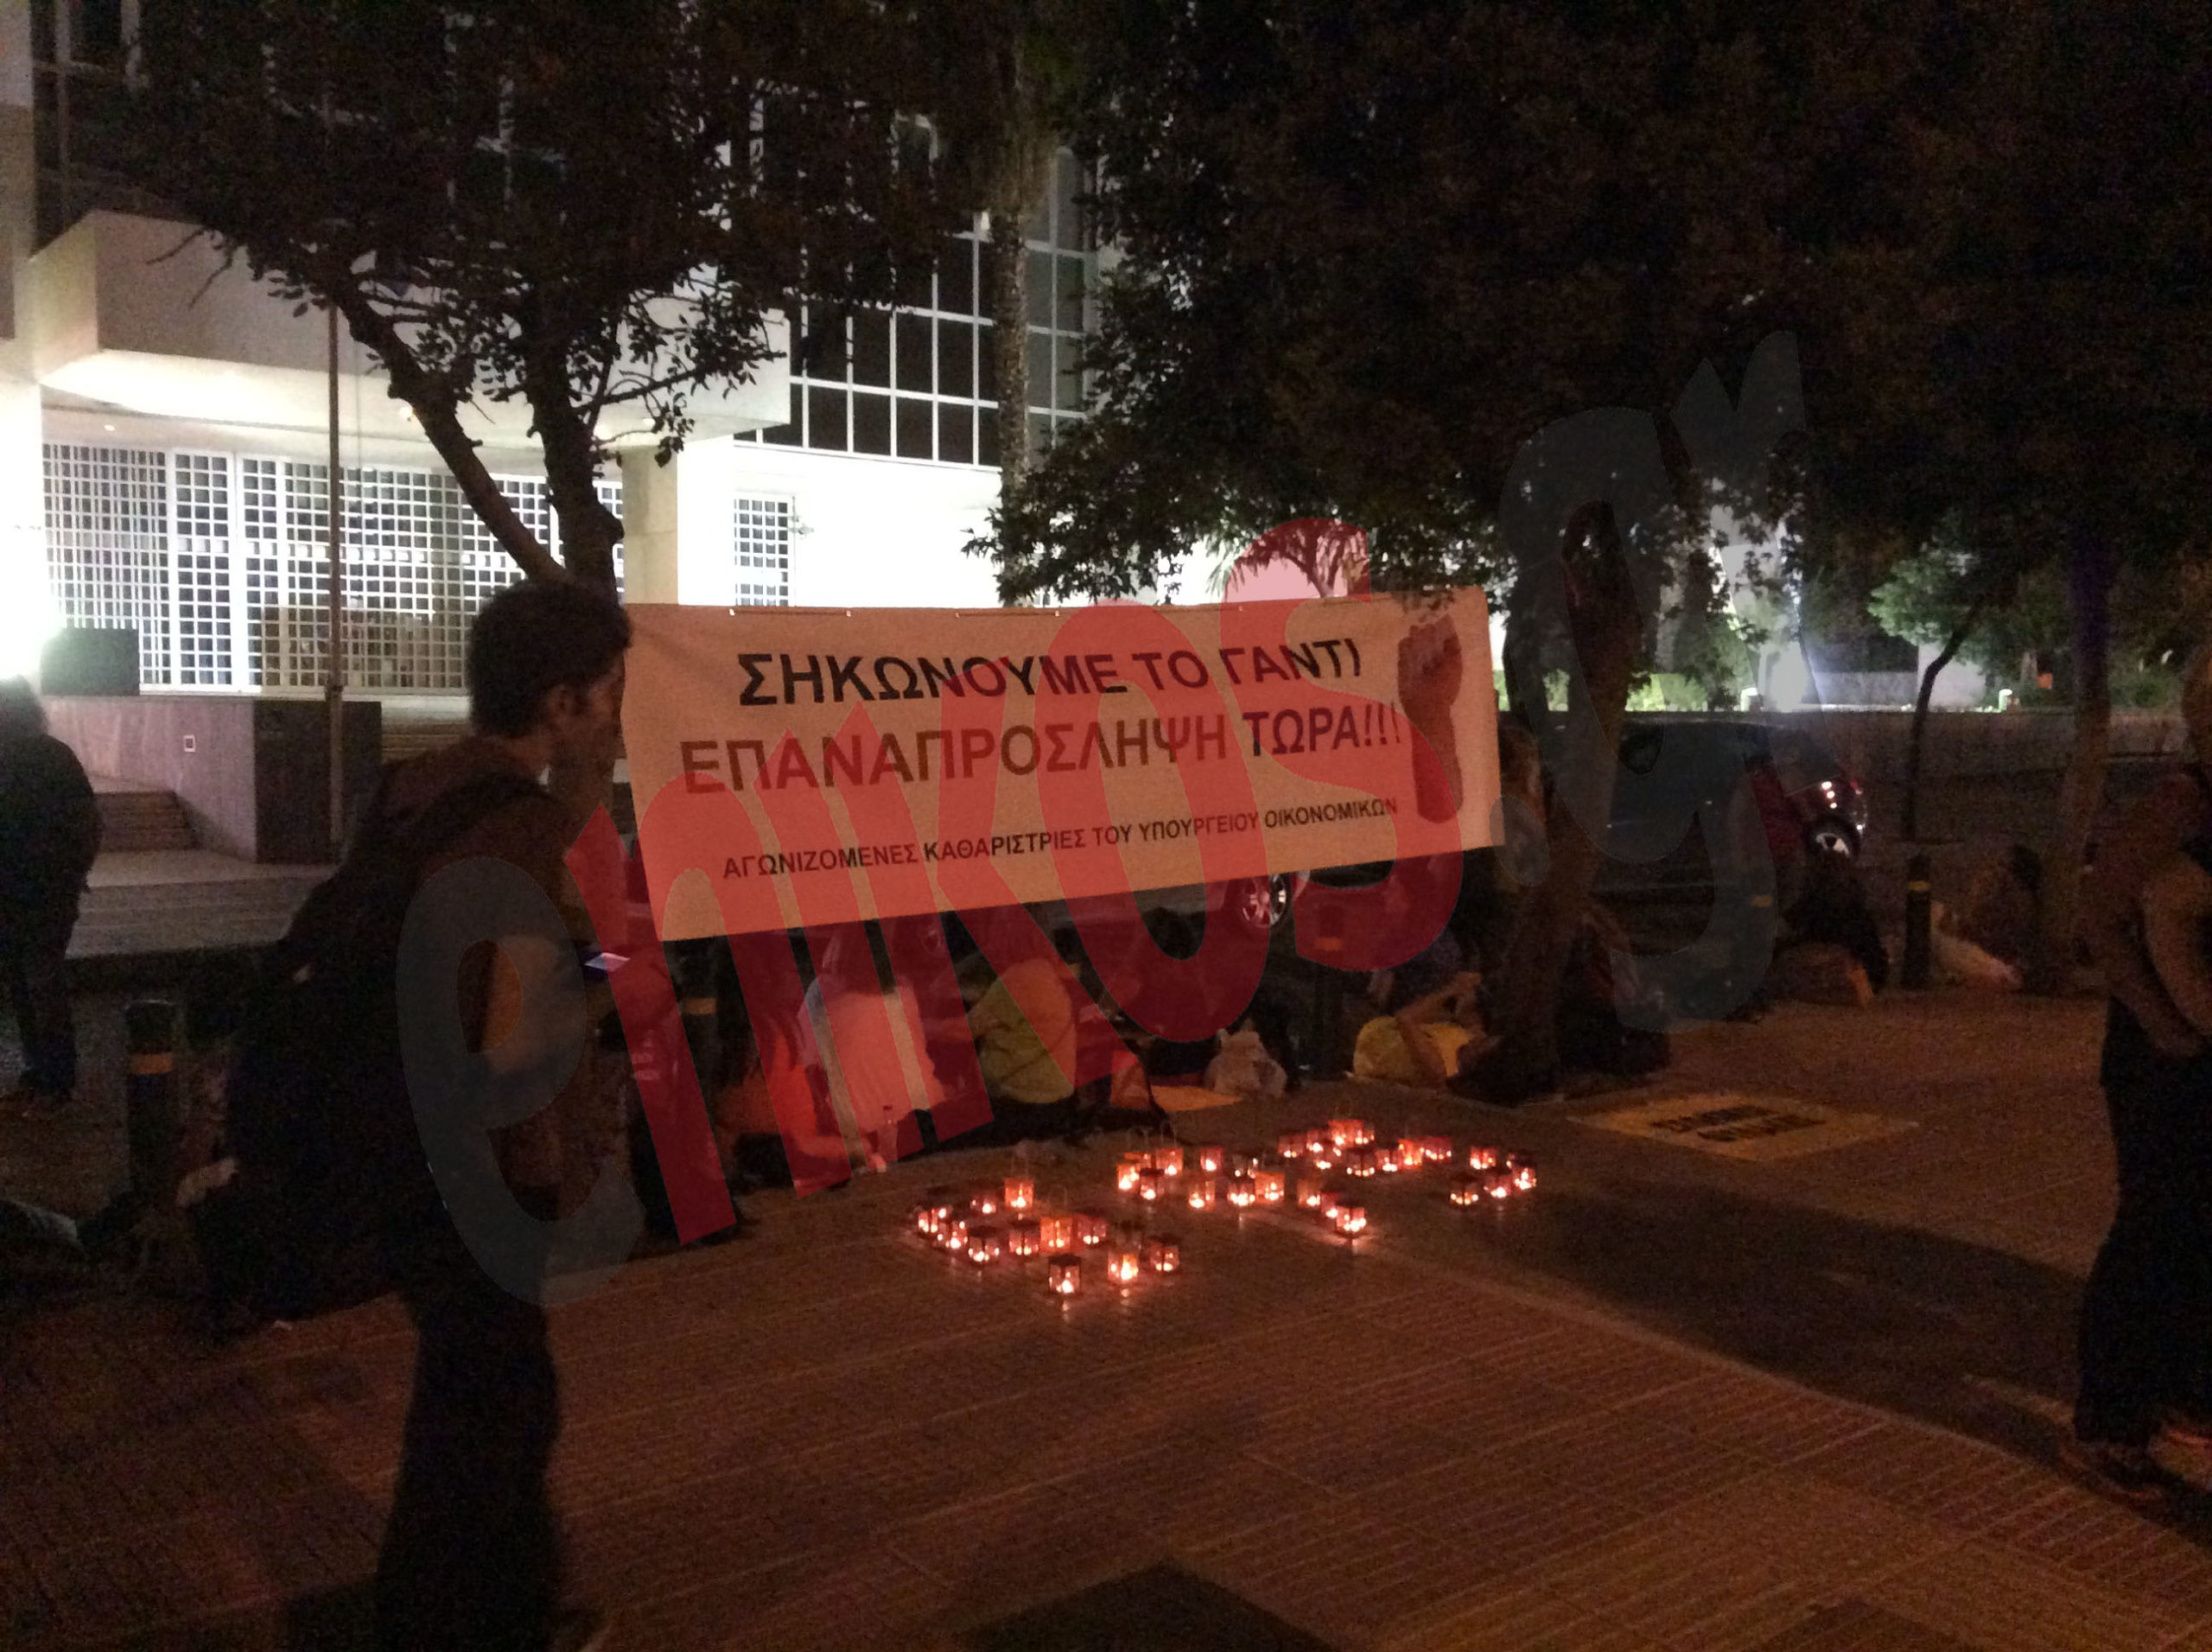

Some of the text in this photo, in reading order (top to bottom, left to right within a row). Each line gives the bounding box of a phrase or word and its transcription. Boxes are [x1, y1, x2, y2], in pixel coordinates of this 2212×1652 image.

[1132, 649, 1208, 690] ΤΟ
[1220, 638, 1360, 684] ΓΑΝΤΙ
[680, 713, 1226, 794] ΕΠΑΝΑΠΡΟΣΛΗΨΗ
[723, 842, 918, 880] ΑΓΩΝΙΖΟΜΕΝΕΣ
[1092, 824, 1131, 846] ΤΟΥ
